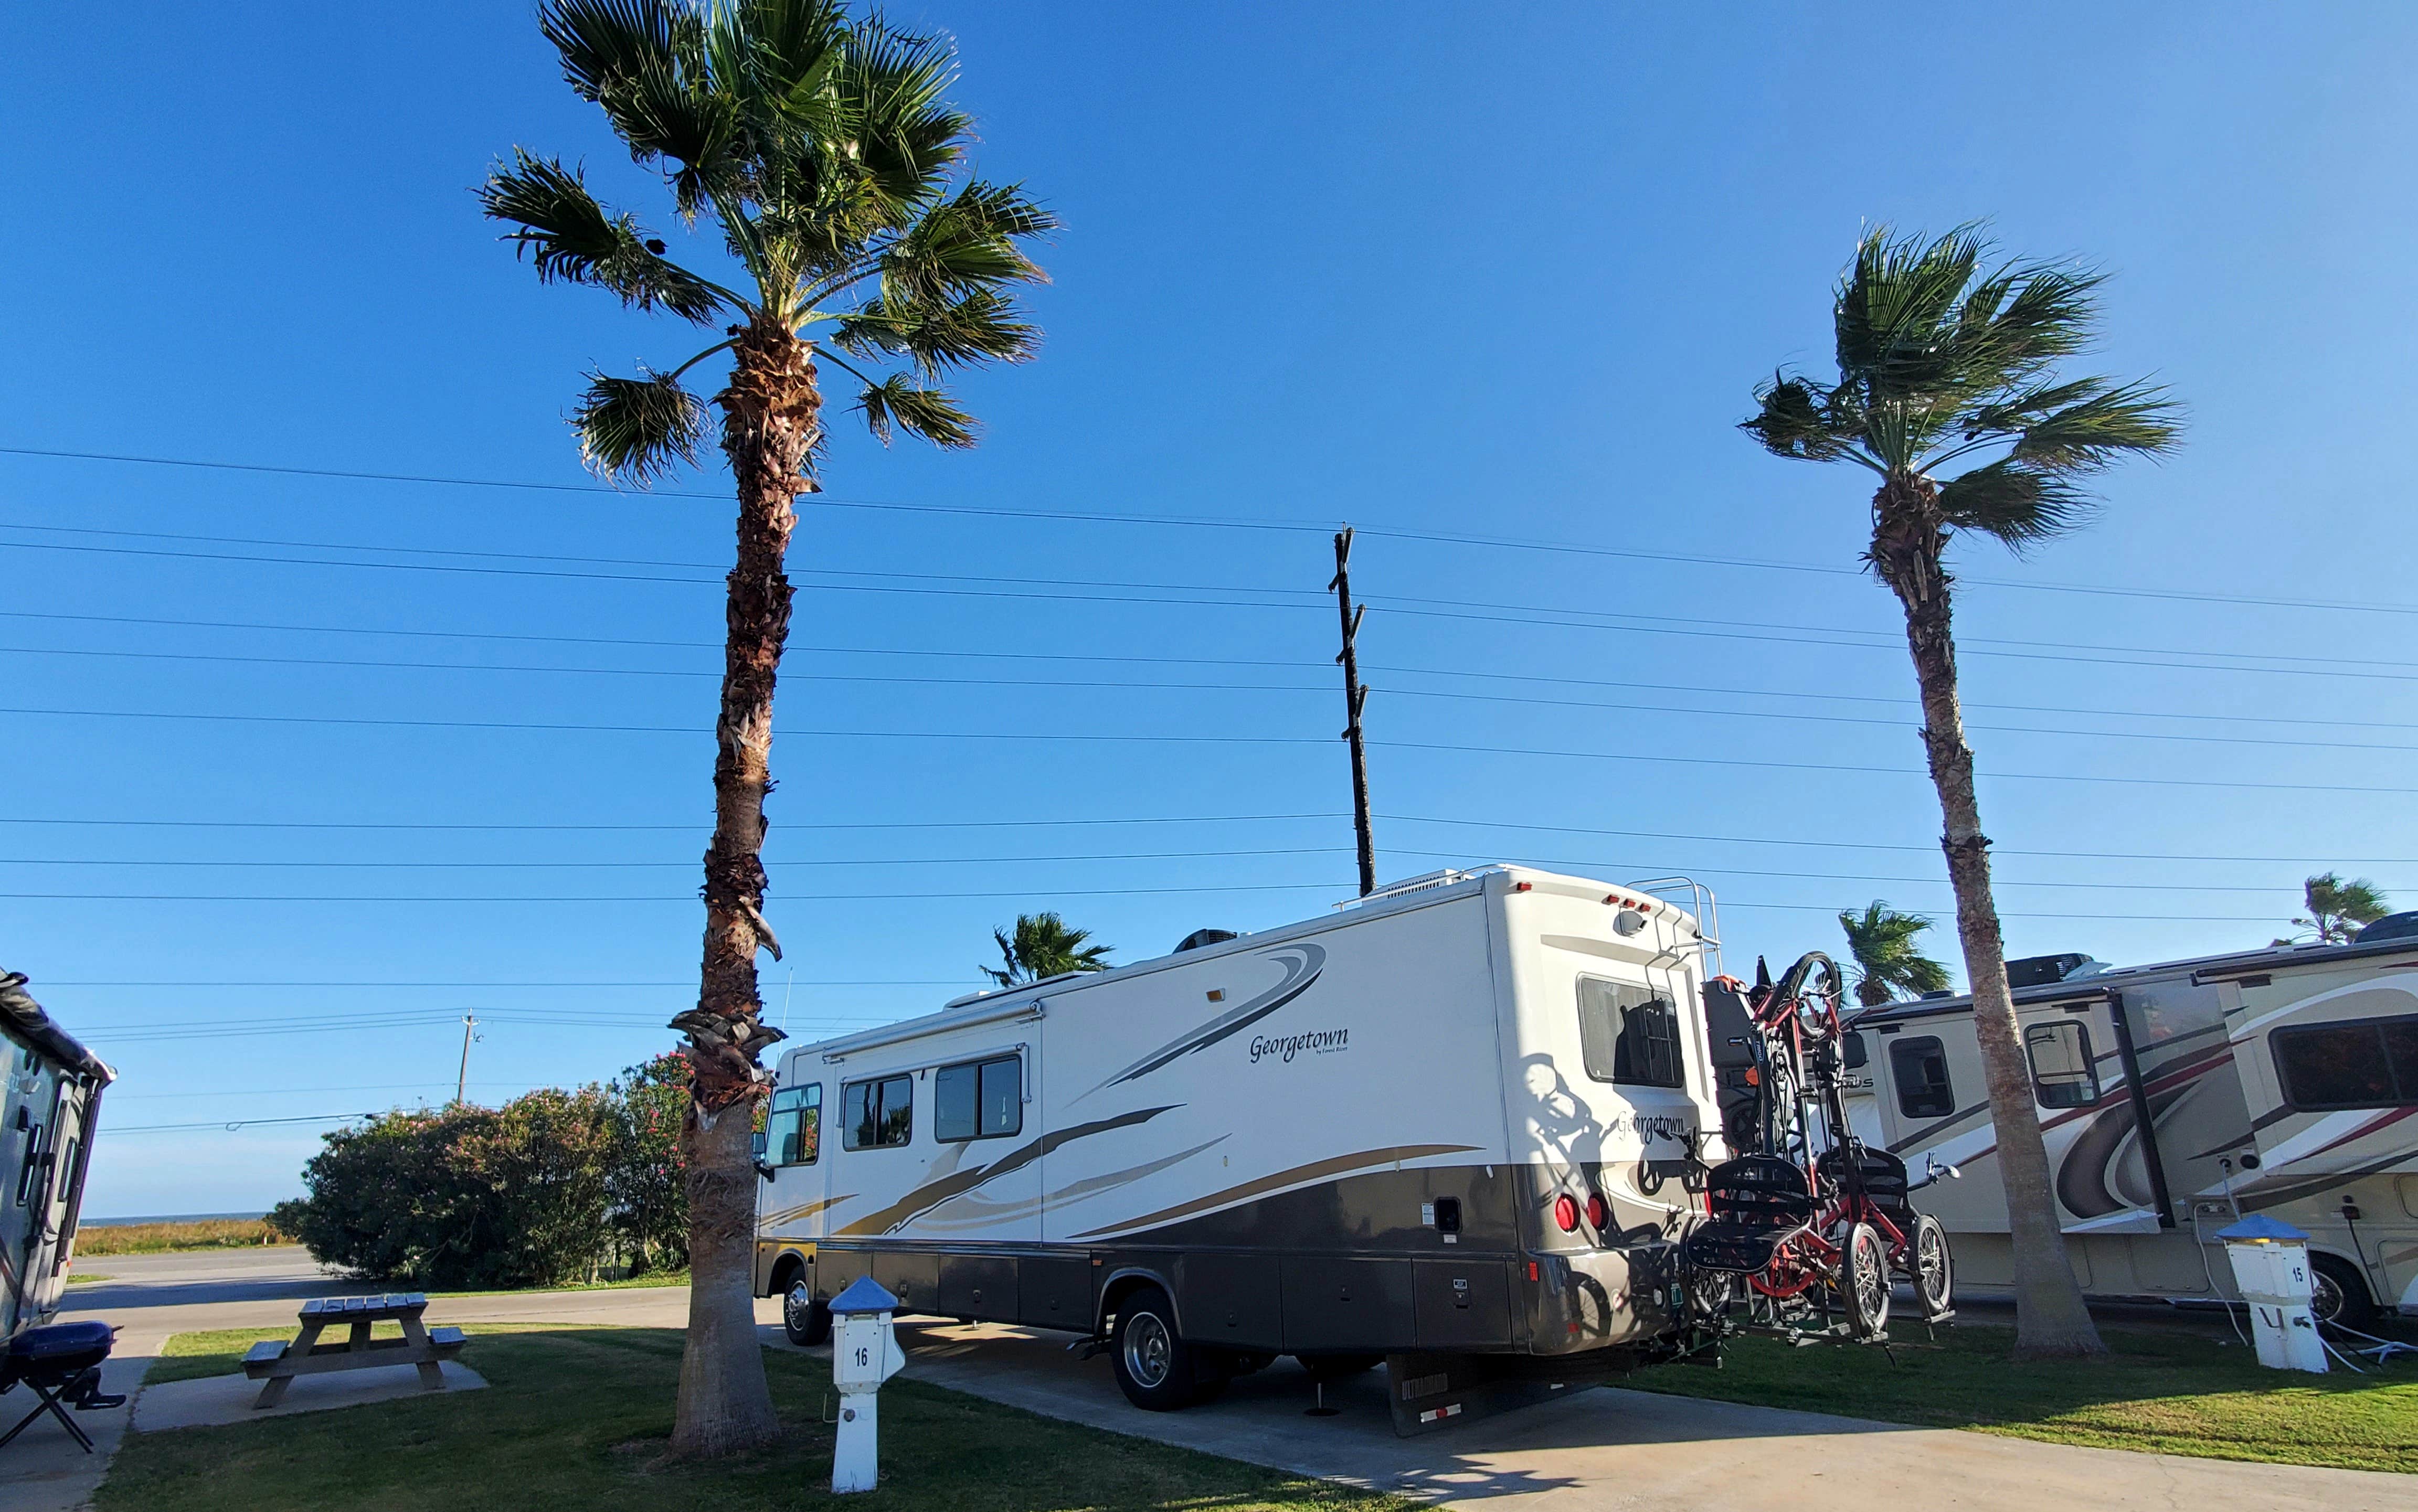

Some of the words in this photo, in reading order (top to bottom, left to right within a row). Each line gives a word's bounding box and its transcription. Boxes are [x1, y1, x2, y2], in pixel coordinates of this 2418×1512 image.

[1250, 1029, 1348, 1063] Georgetown
[2293, 1267, 2303, 1282] 15
[855, 1347, 867, 1367] 16
